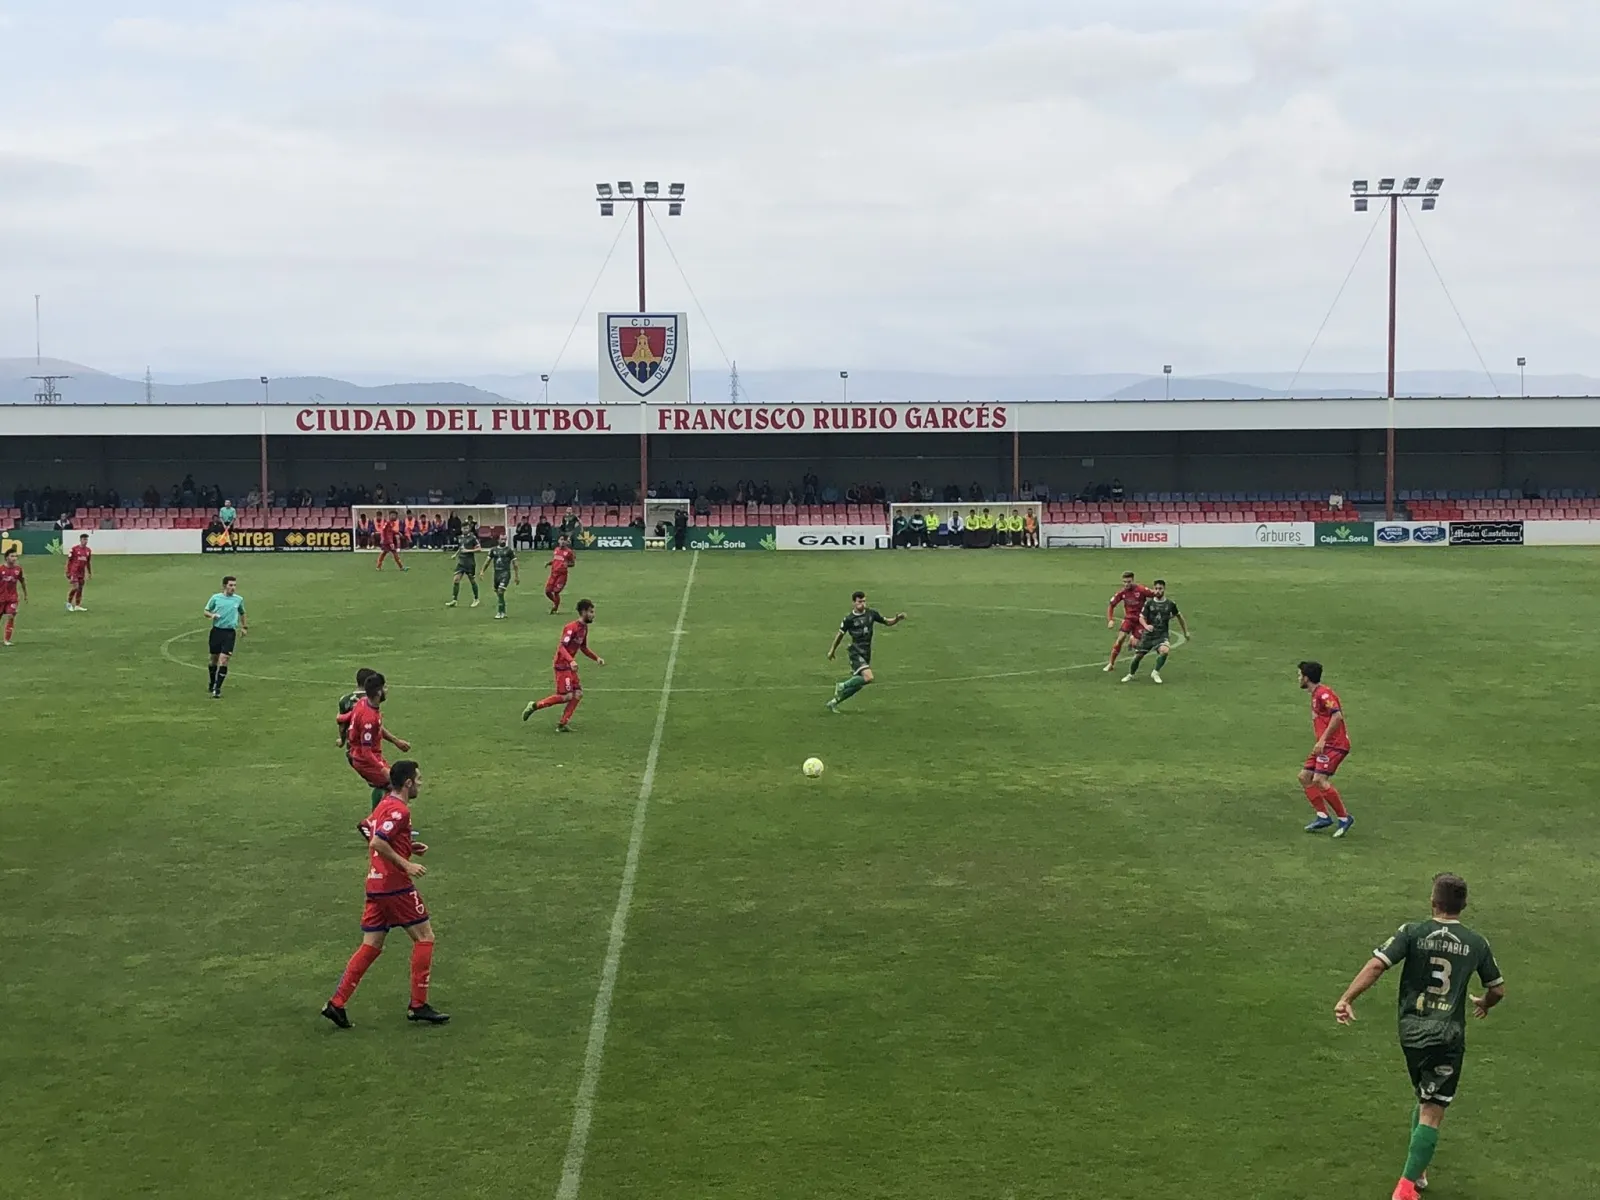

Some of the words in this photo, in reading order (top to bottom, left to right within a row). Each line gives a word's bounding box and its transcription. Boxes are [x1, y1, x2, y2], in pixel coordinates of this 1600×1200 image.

[610, 325, 630, 379] NUMANCIA
[654, 366, 667, 380] DE
[663, 326, 674, 363] SORIA
[296, 408, 416, 431] CIUDAD
[426, 408, 483, 431] DEL
[492, 408, 612, 431] FUTBOL
[658, 407, 805, 430] FRANCISCO
[813, 407, 897, 430] RUBIO
[905, 402, 1007, 429] GARCÉS
[306, 531, 351, 546] errea
[1120, 529, 1168, 543] vinuesa
[1320, 535, 1337, 544] Caja
[1348, 535, 1369, 543] Soria
[1481, 528, 1519, 537] Castellano
[597, 539, 634, 548] RGA
[690, 540, 710, 550] Caja
[723, 540, 746, 549] Soria
[797, 535, 865, 546] GARI
[1442, 940, 1470, 957] PABLO
[1427, 957, 1452, 996] 3
